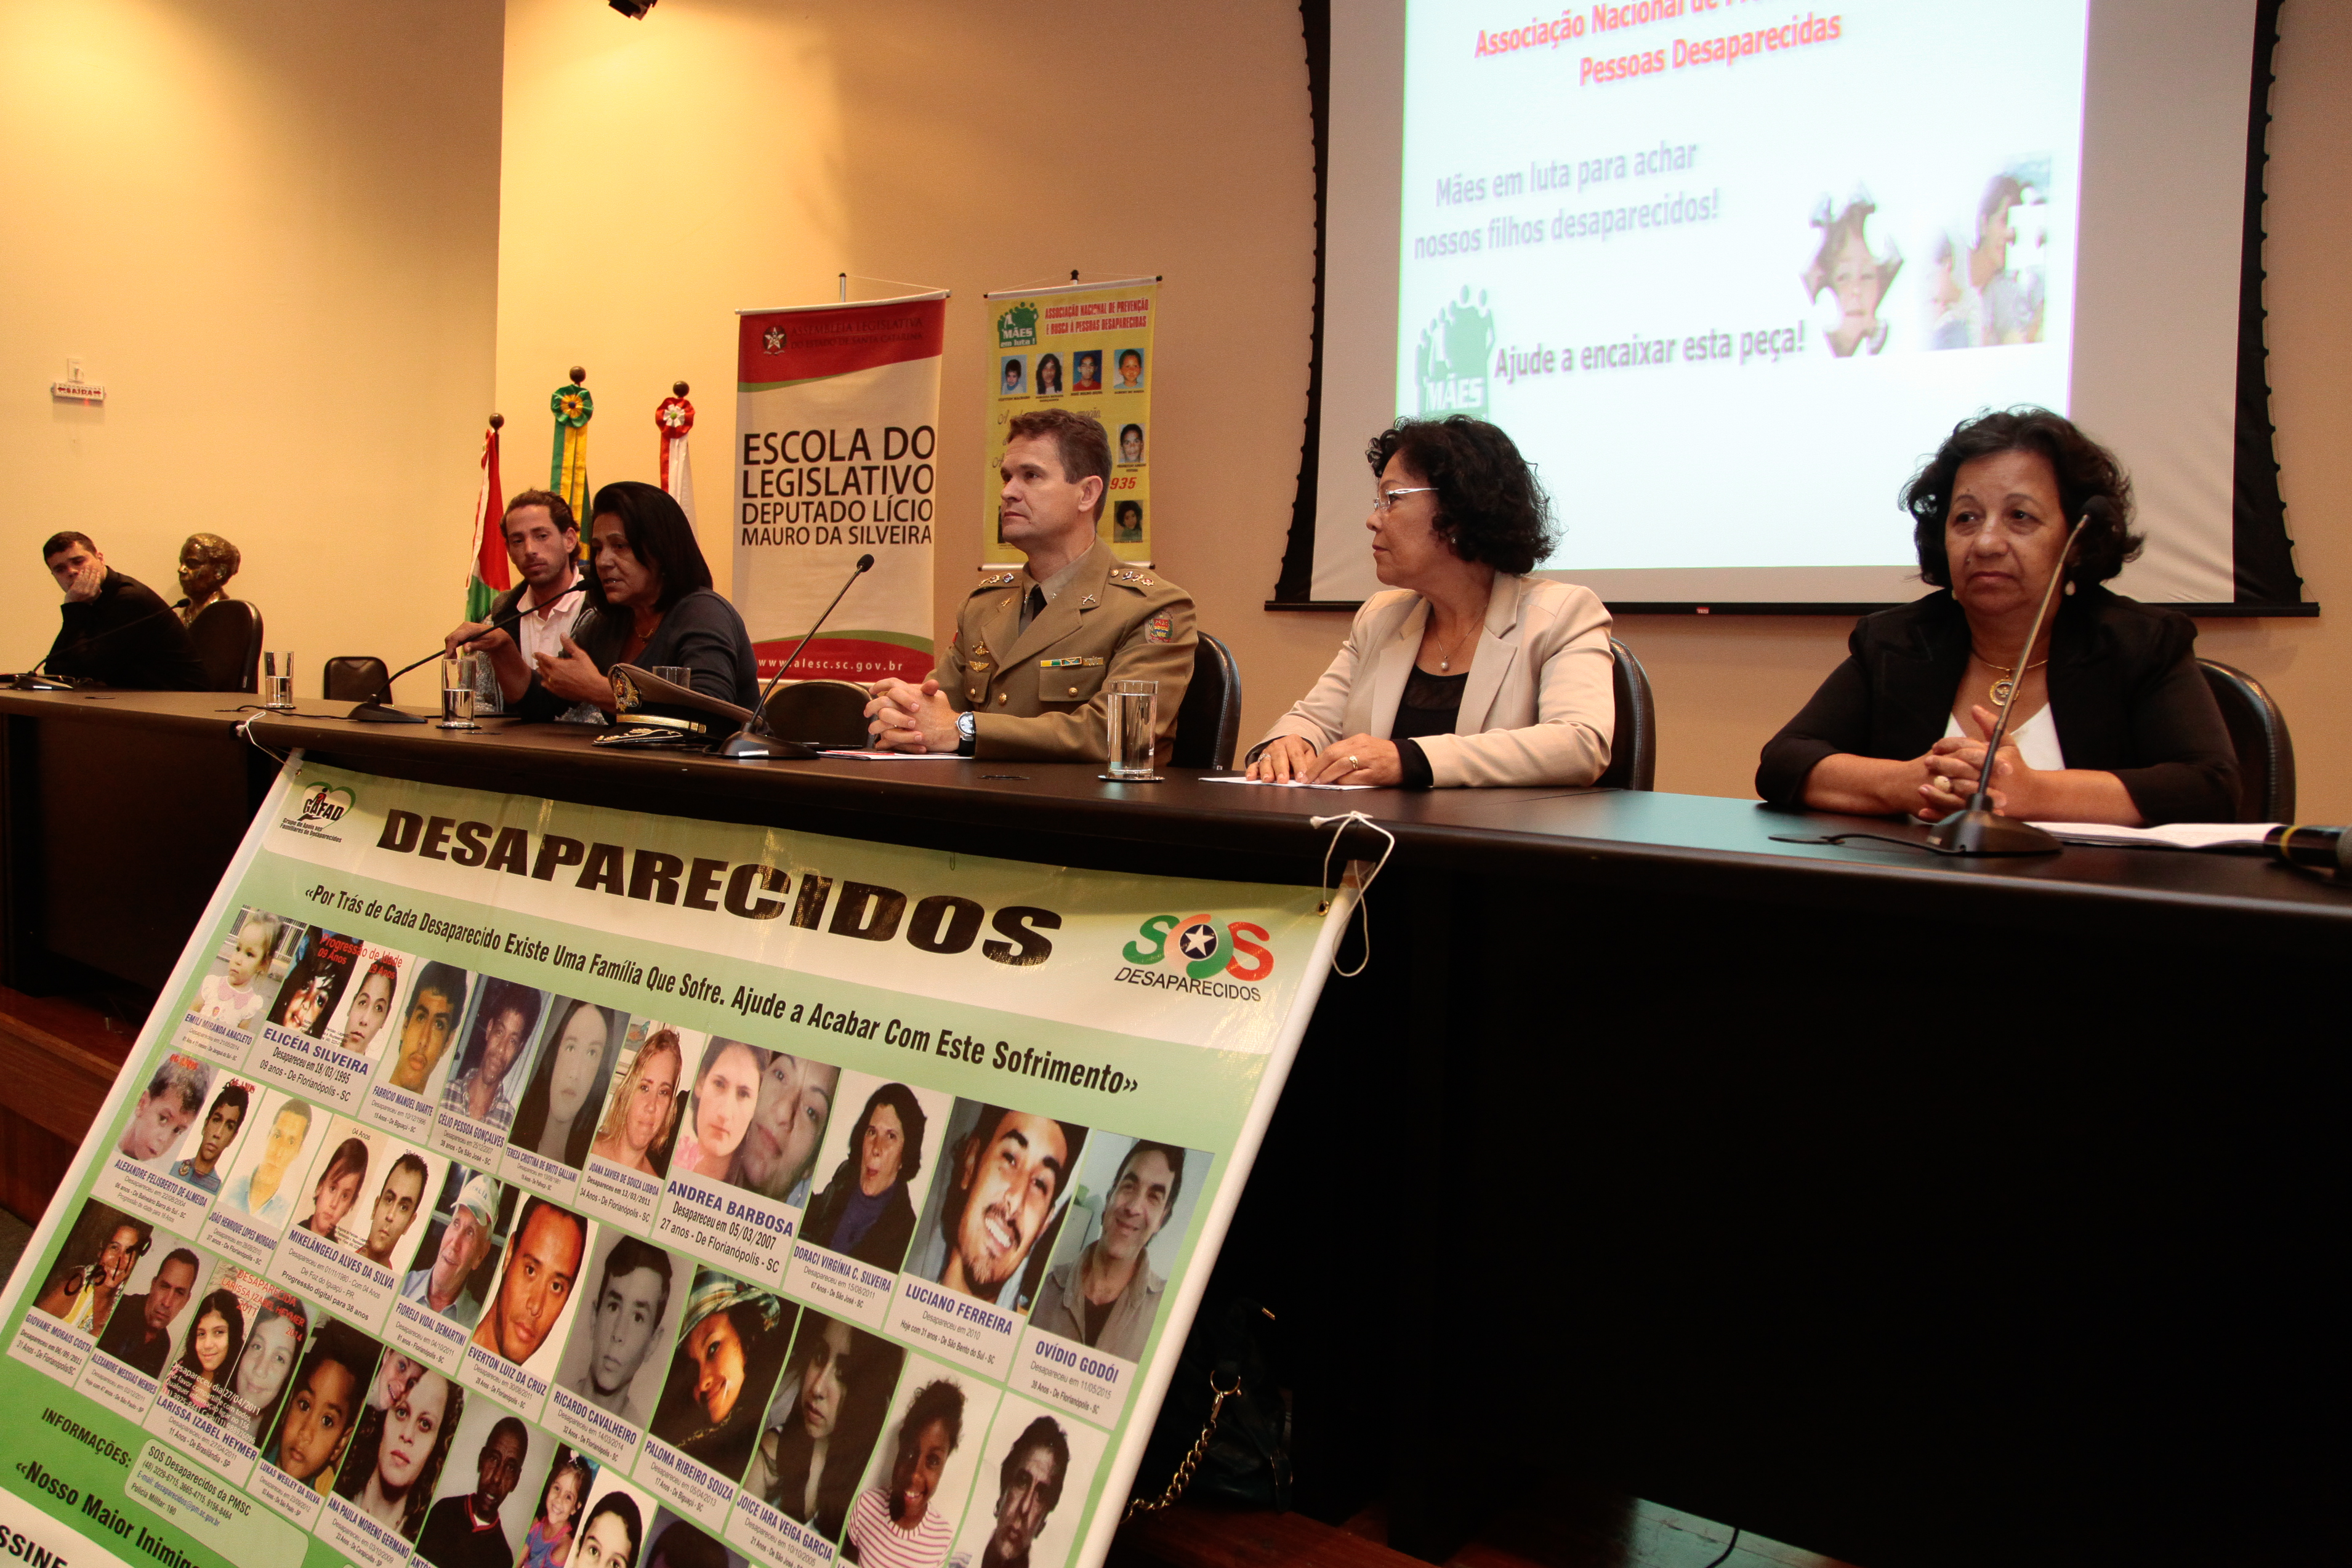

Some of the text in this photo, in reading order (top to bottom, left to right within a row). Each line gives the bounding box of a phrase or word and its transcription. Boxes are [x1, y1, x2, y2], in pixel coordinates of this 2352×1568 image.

[1475, 10, 1584, 58] Associação
[1592, 0, 1683, 33] Nacional
[1580, 12, 1841, 86] Pessoas Desaparecidas
[1435, 140, 1697, 207] Mães em luta para achar
[1414, 188, 1718, 260] nossos filhos desaparecidos!
[1045, 298, 1149, 319] ASSOCIAÇÃO NACIONAL DE PREVENÇÃO
[1051, 323, 1068, 334] BUSCA
[1076, 320, 1100, 332] PESSOAS
[1101, 316, 1146, 330] DESAPARECIDAS
[1002, 328, 1032, 339] MÃES
[1495, 320, 1803, 384] Ajude a encaixar esta peça!
[1425, 373, 1483, 411] MÃES
[744, 425, 935, 465] ESCOLA DO
[743, 464, 934, 499] LEGISLATIVO
[1110, 477, 1137, 489] 935
[742, 495, 933, 525] DEPUTADO LÍCIO
[742, 525, 932, 545] MAURO DA SILVEIRA
[759, 658, 902, 672] www.alesc.sc.gov.br
[303, 799, 344, 821] GAFAD
[280, 823, 303, 834] Familiares
[310, 830, 342, 842] Desaparecidos
[377, 809, 1062, 966] DESAPARECIDOS
[1122, 914, 1274, 982] SOS
[338, 888, 364, 915] Trás
[365, 896, 382, 919] de
[384, 903, 416, 929] Cada
[419, 911, 501, 952] Desaparecido
[505, 932, 549, 962] Existe
[554, 944, 587, 971] Uma
[588, 954, 644, 986] Família
[646, 966, 677, 994] Que
[679, 973, 725, 1006] Sofre.
[730, 984, 785, 1022] Ajude
[789, 1005, 803, 1023] a
[807, 1002, 881, 1040] Acabar
[884, 1018, 930, 1053] Com
[936, 1029, 985, 1064] Este
[1114, 967, 1261, 1002] DESAPARECIDOS
[263, 1027, 308, 1053] ELICÉIA
[313, 1046, 369, 1075] SILVEIRA
[273, 1047, 350, 1084] Desapareceu em 18/03/1995
[259, 1060, 268, 1069] 09
[270, 1065, 284, 1076] anos
[288, 1071, 298, 1080] De
[298, 1073, 336, 1097] Florianópolis
[340, 1090, 351, 1101] SC
[667, 1181, 793, 1236] ANDREA BARBOSA
[672, 1201, 776, 1250] Desapareceu em 05/03/2007
[288, 1229, 339, 1261] MIKELÂNGELO
[339, 1254, 362, 1272] ALVES
[361, 1265, 373, 1279] DA
[373, 1271, 395, 1289] SILVA
[660, 1218, 671, 1230] 27
[671, 1224, 690, 1238] anos
[696, 1231, 706, 1245] De
[708, 1236, 759, 1265] Florianópolis
[767, 1258, 779, 1272] SC
[282, 1271, 368, 1320] Progressão digital para 38 anos
[906, 1284, 1012, 1335] LUCIANO FERREIRA
[923, 1311, 981, 1340] Desapareceu em 2010
[468, 1346, 547, 1396] EVERTON LUIZ DA CRUZ
[1036, 1340, 1119, 1383] OVÍDIO GODÓI
[42, 1408, 132, 1468] INFORMAÇÕES:
[156, 1396, 257, 1460] LARISSA IZABEL HEYMER
[554, 1391, 637, 1445] RICARDO CAVALHEIRO
[558, 1409, 624, 1450] Desapareceu em 14/03/2014
[137, 1470, 153, 1485] E-mail:
[142, 1460, 154, 1472] (48)
[148, 1446, 251, 1516] SOS Desaparecidos da PMSC
[645, 1441, 733, 1502] PALOMA RIBEIRO SOUZA
[81, 1494, 134, 1538] Maior
[131, 1482, 177, 1516] Polícia Militar: 190
